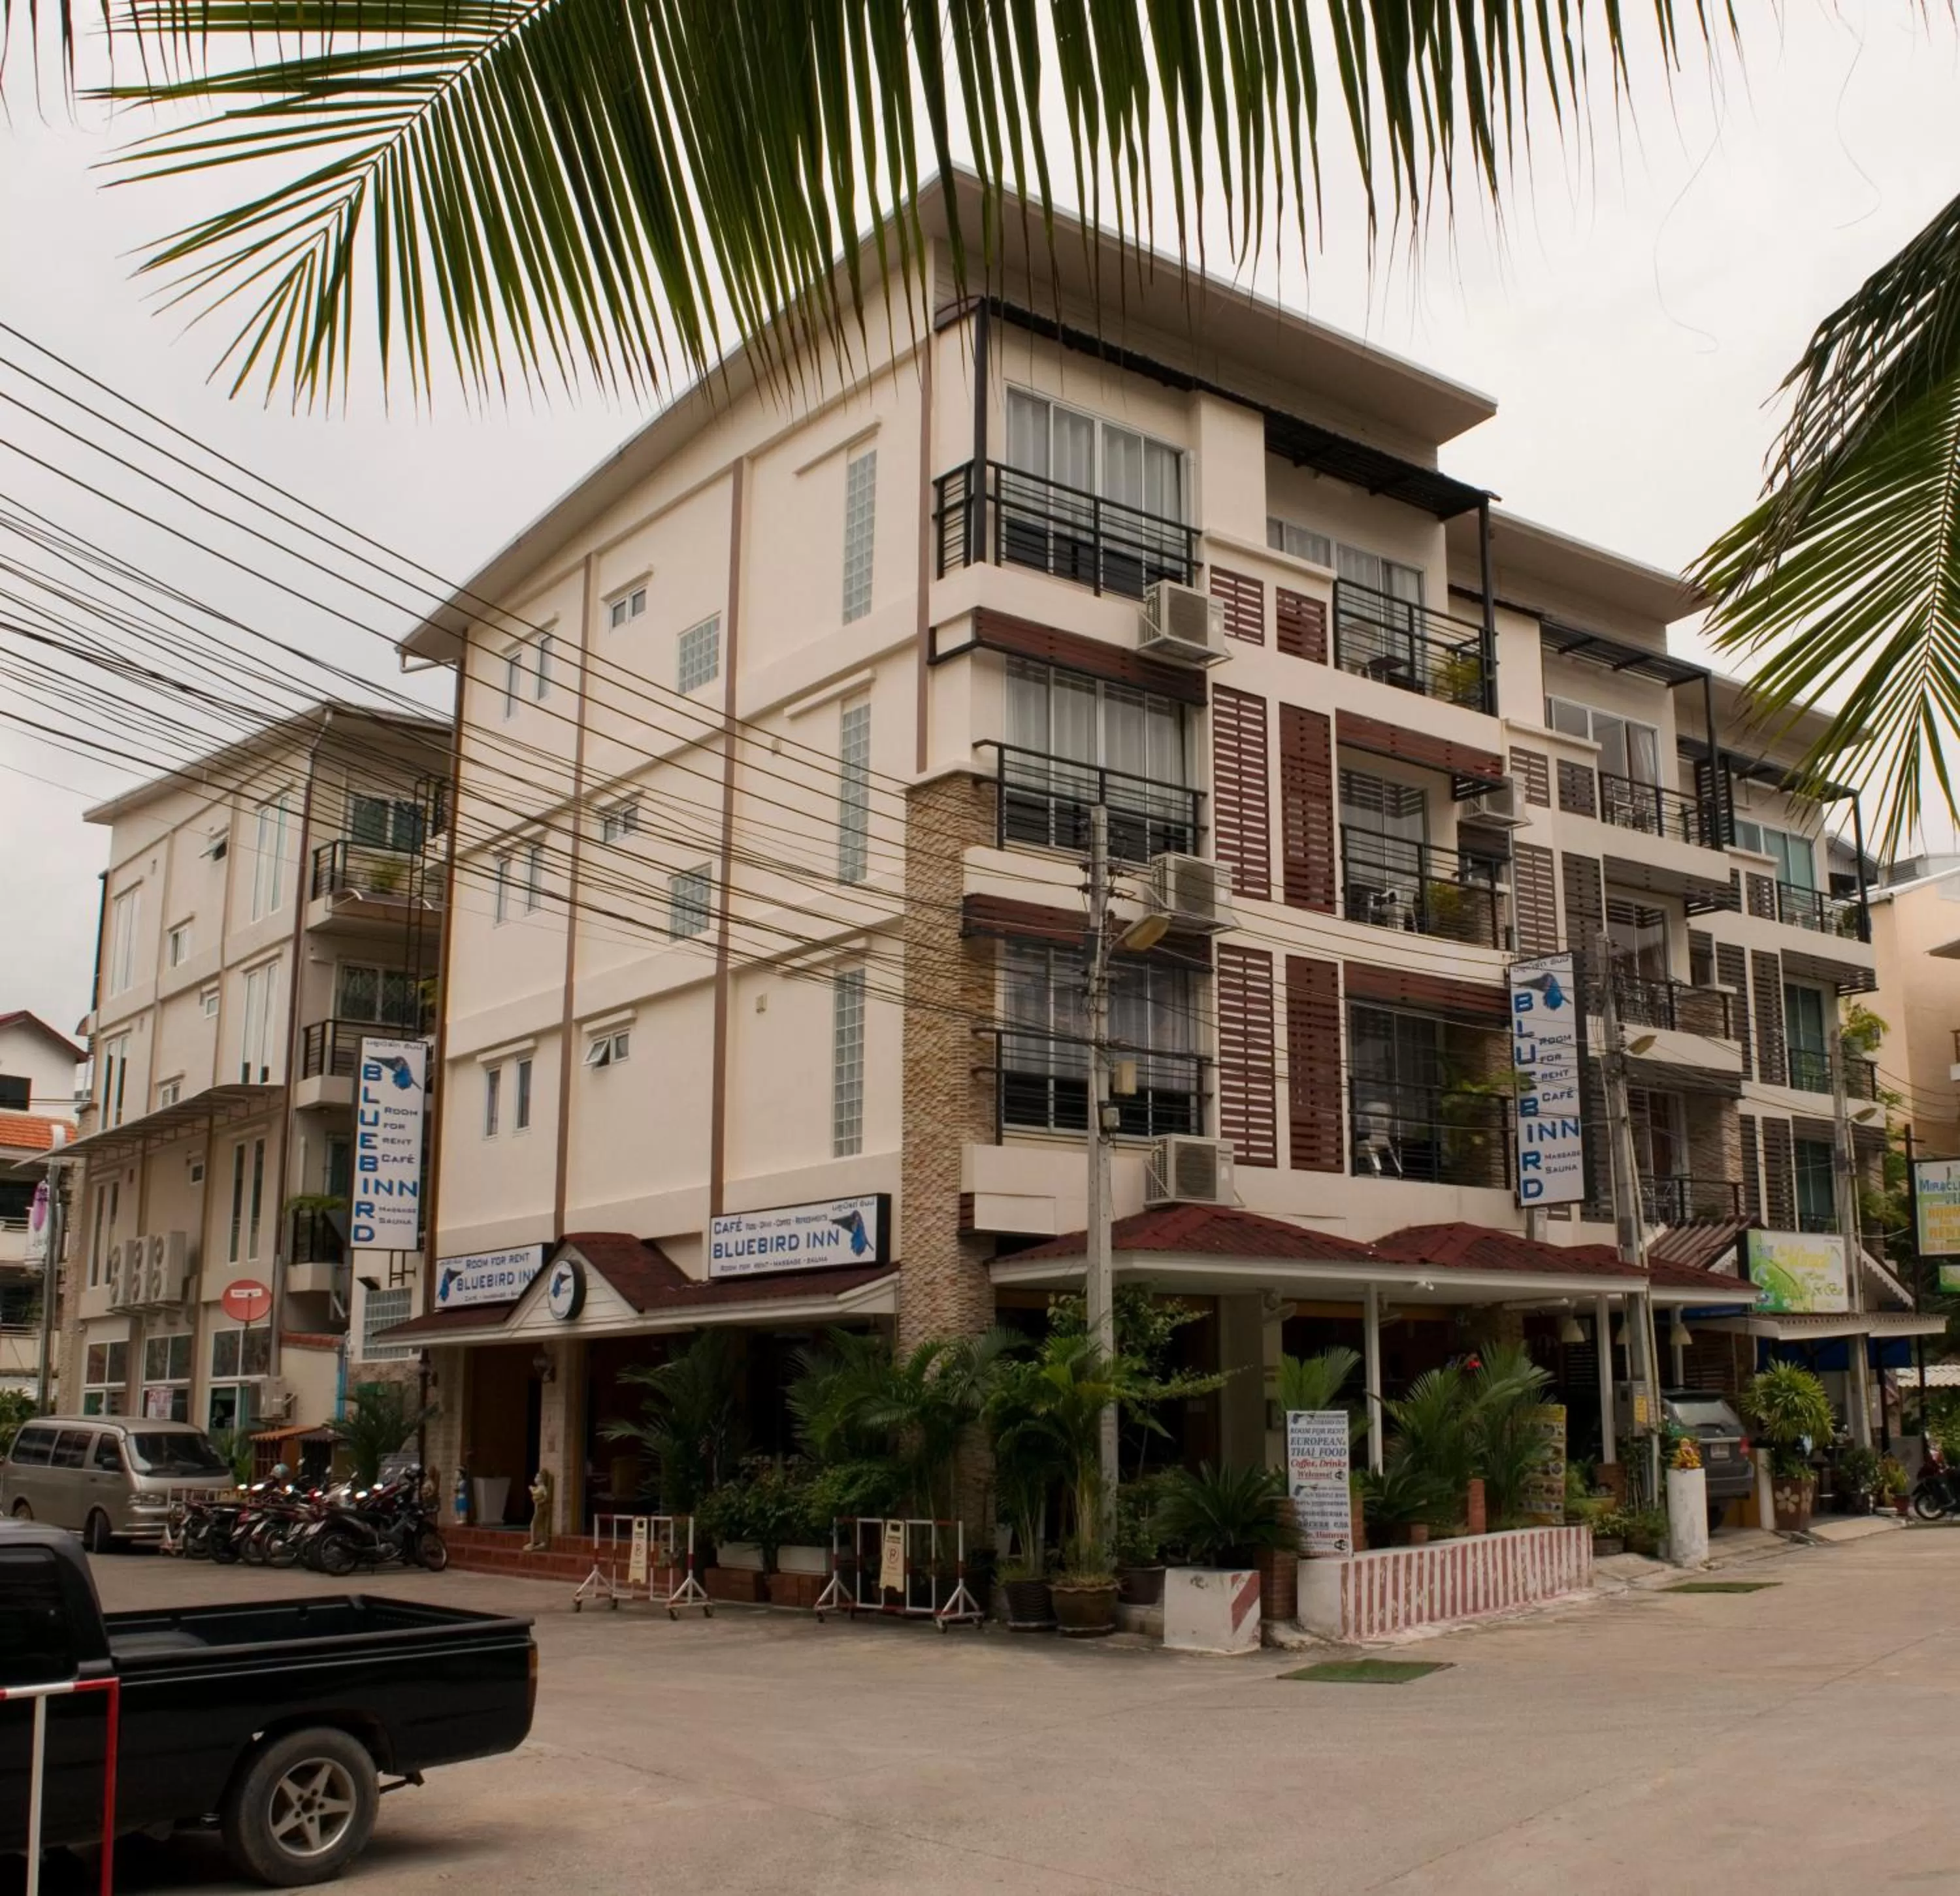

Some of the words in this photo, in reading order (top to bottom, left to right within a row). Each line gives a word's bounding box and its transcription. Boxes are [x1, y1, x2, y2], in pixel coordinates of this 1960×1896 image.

[1541, 1053, 1562, 1064] FOR
[1541, 1069, 1569, 1080] RENT
[1543, 1087, 1574, 1102] CAFÉ
[384, 1107, 418, 1117] ROOM
[1527, 1118, 1579, 1143] INN
[382, 1137, 413, 1146] RENT
[353, 1064, 382, 1242] BLUEBIRD
[382, 1153, 415, 1164] CAFÉ
[1545, 1164, 1578, 1174] SAUNA
[363, 1178, 418, 1198] INN
[714, 1217, 742, 1234] CAFÉ
[713, 1234, 800, 1258] BLUEBIRD
[806, 1230, 840, 1249] INN
[466, 1259, 488, 1269] ROOM
[491, 1255, 506, 1266] FOR
[508, 1252, 530, 1263] RENT
[457, 1271, 514, 1292] BLUEBIRD
[1290, 1437, 1343, 1446] EUROPEAN
[1319, 1447, 1347, 1456] FOOD
